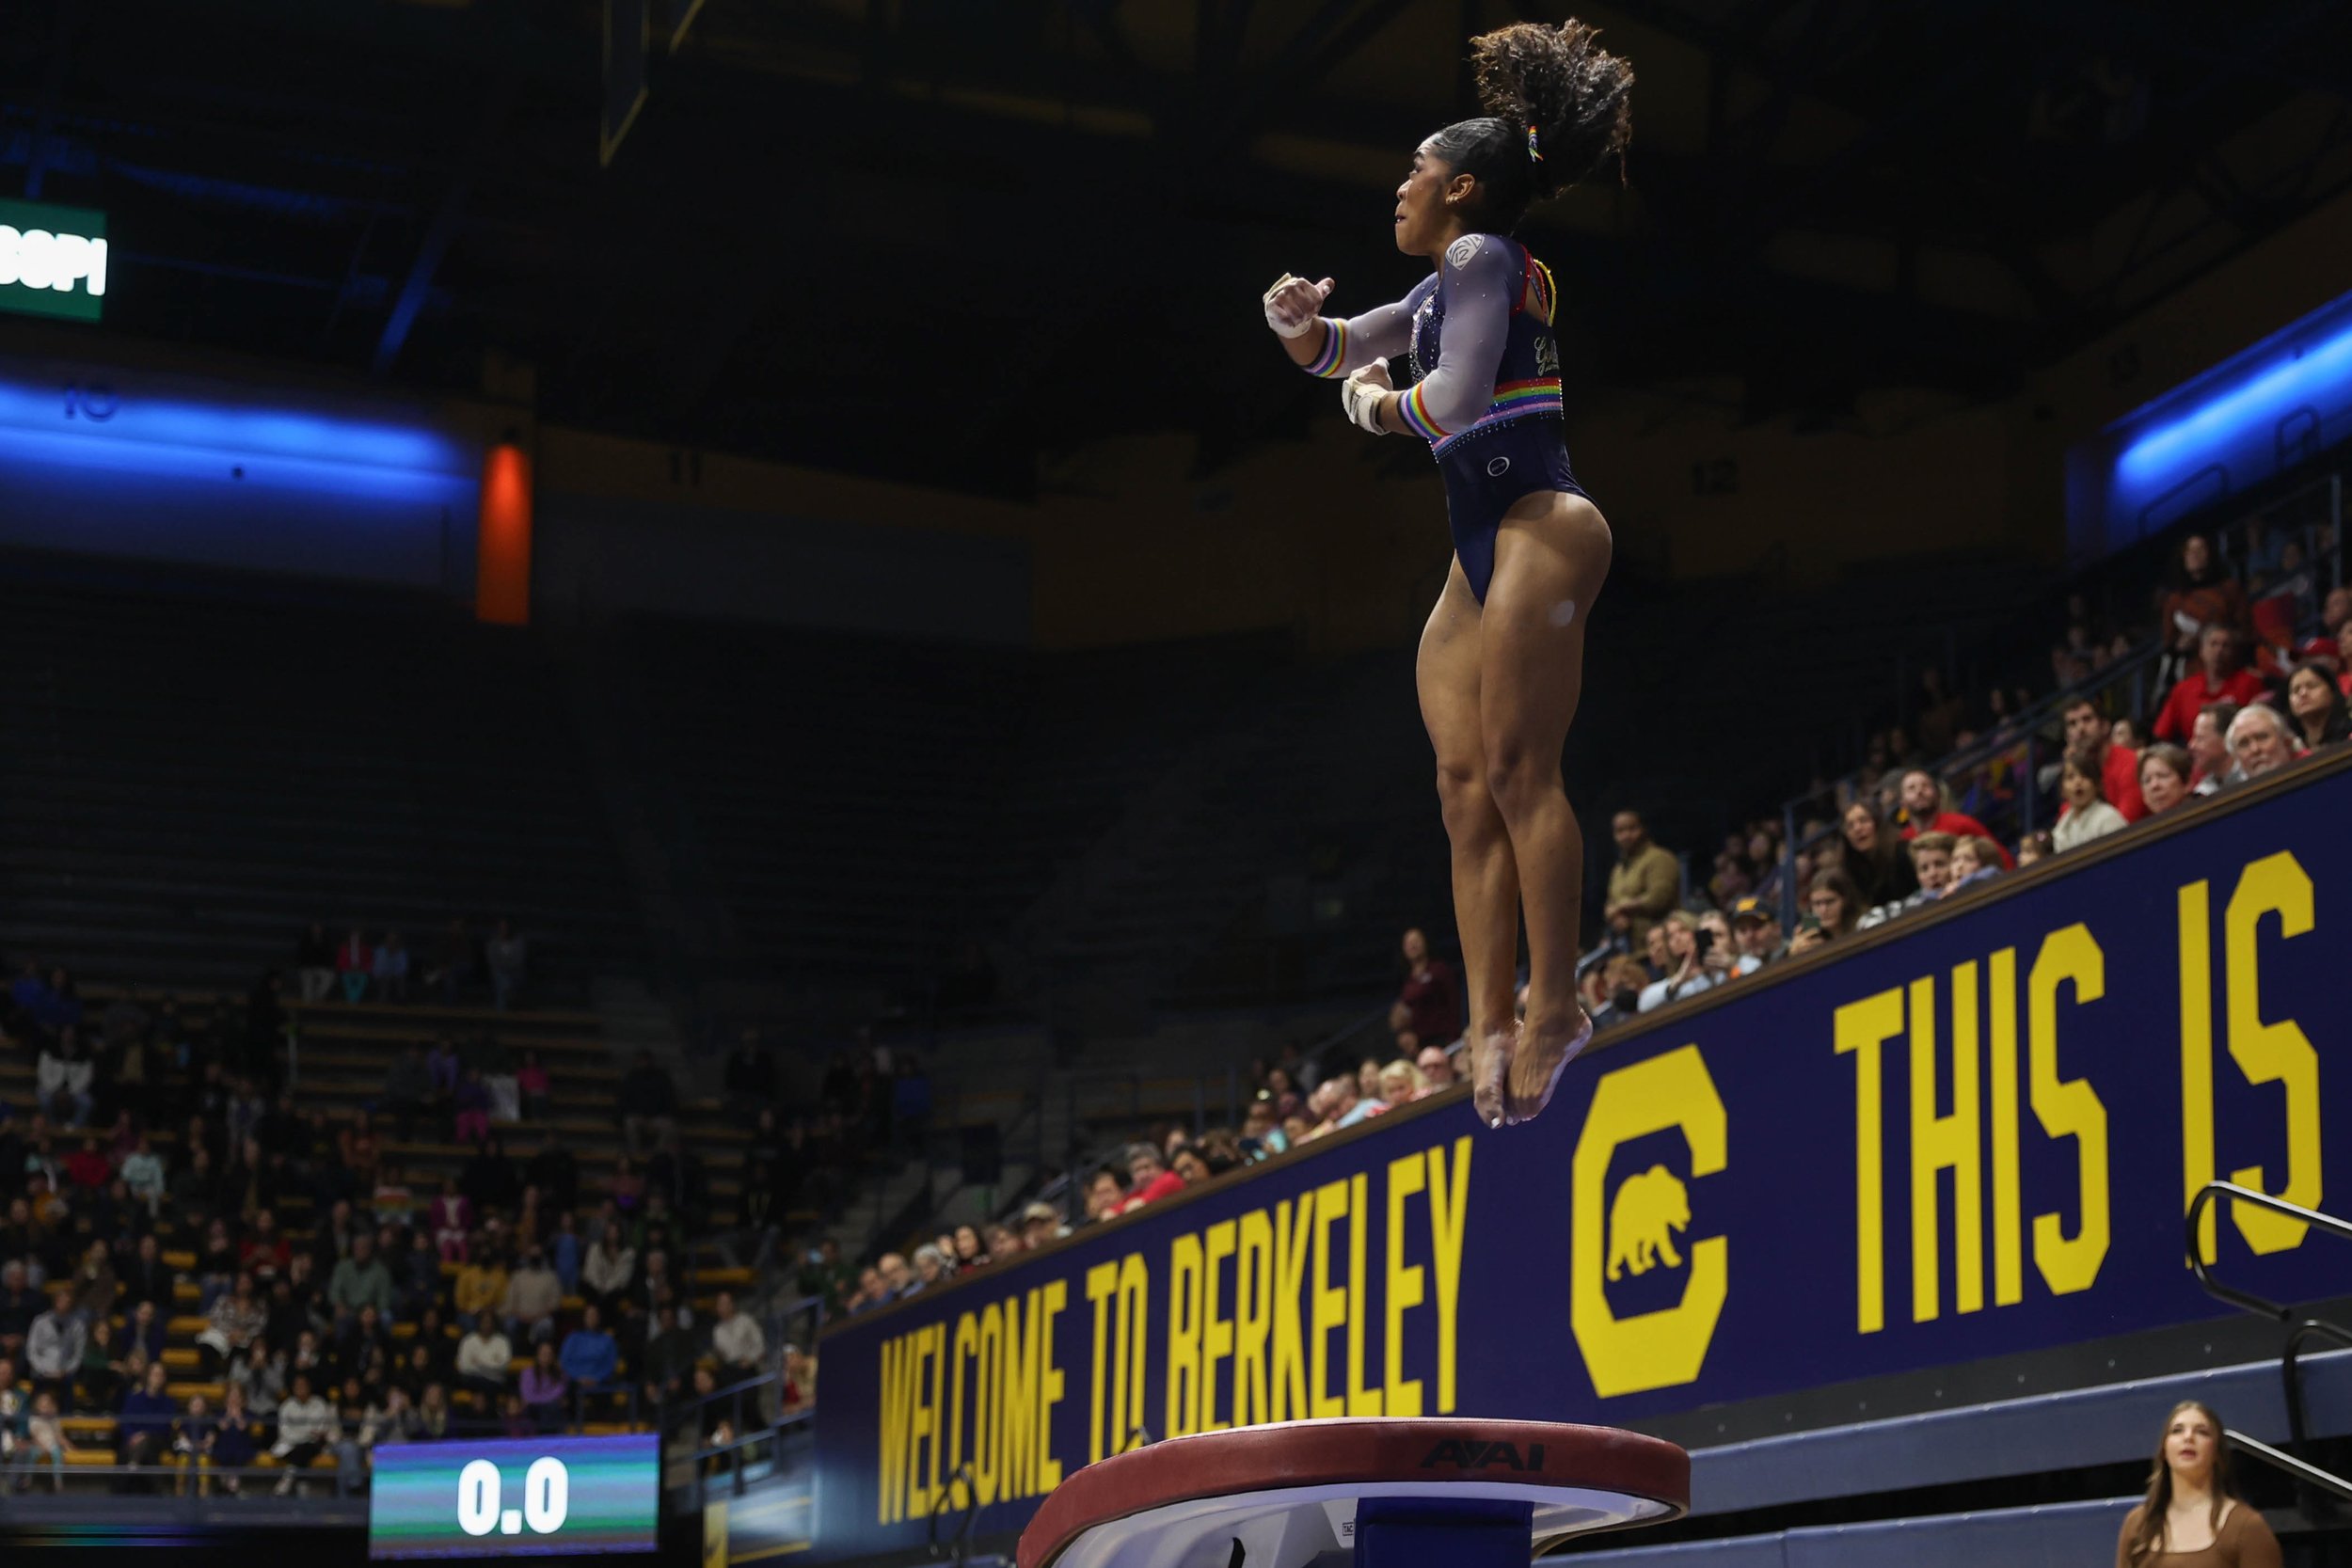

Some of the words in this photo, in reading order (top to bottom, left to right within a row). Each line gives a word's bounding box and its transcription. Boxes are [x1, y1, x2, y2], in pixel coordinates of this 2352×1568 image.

[1834, 922, 2111, 1335] THIS
[2178, 849, 2324, 1270] IS
[457, 1455, 569, 1537] 0.0
[879, 1277, 1068, 1527] WELCOME
[1085, 1251, 1150, 1465] TO
[1164, 1134, 1474, 1441] BERKELEY
